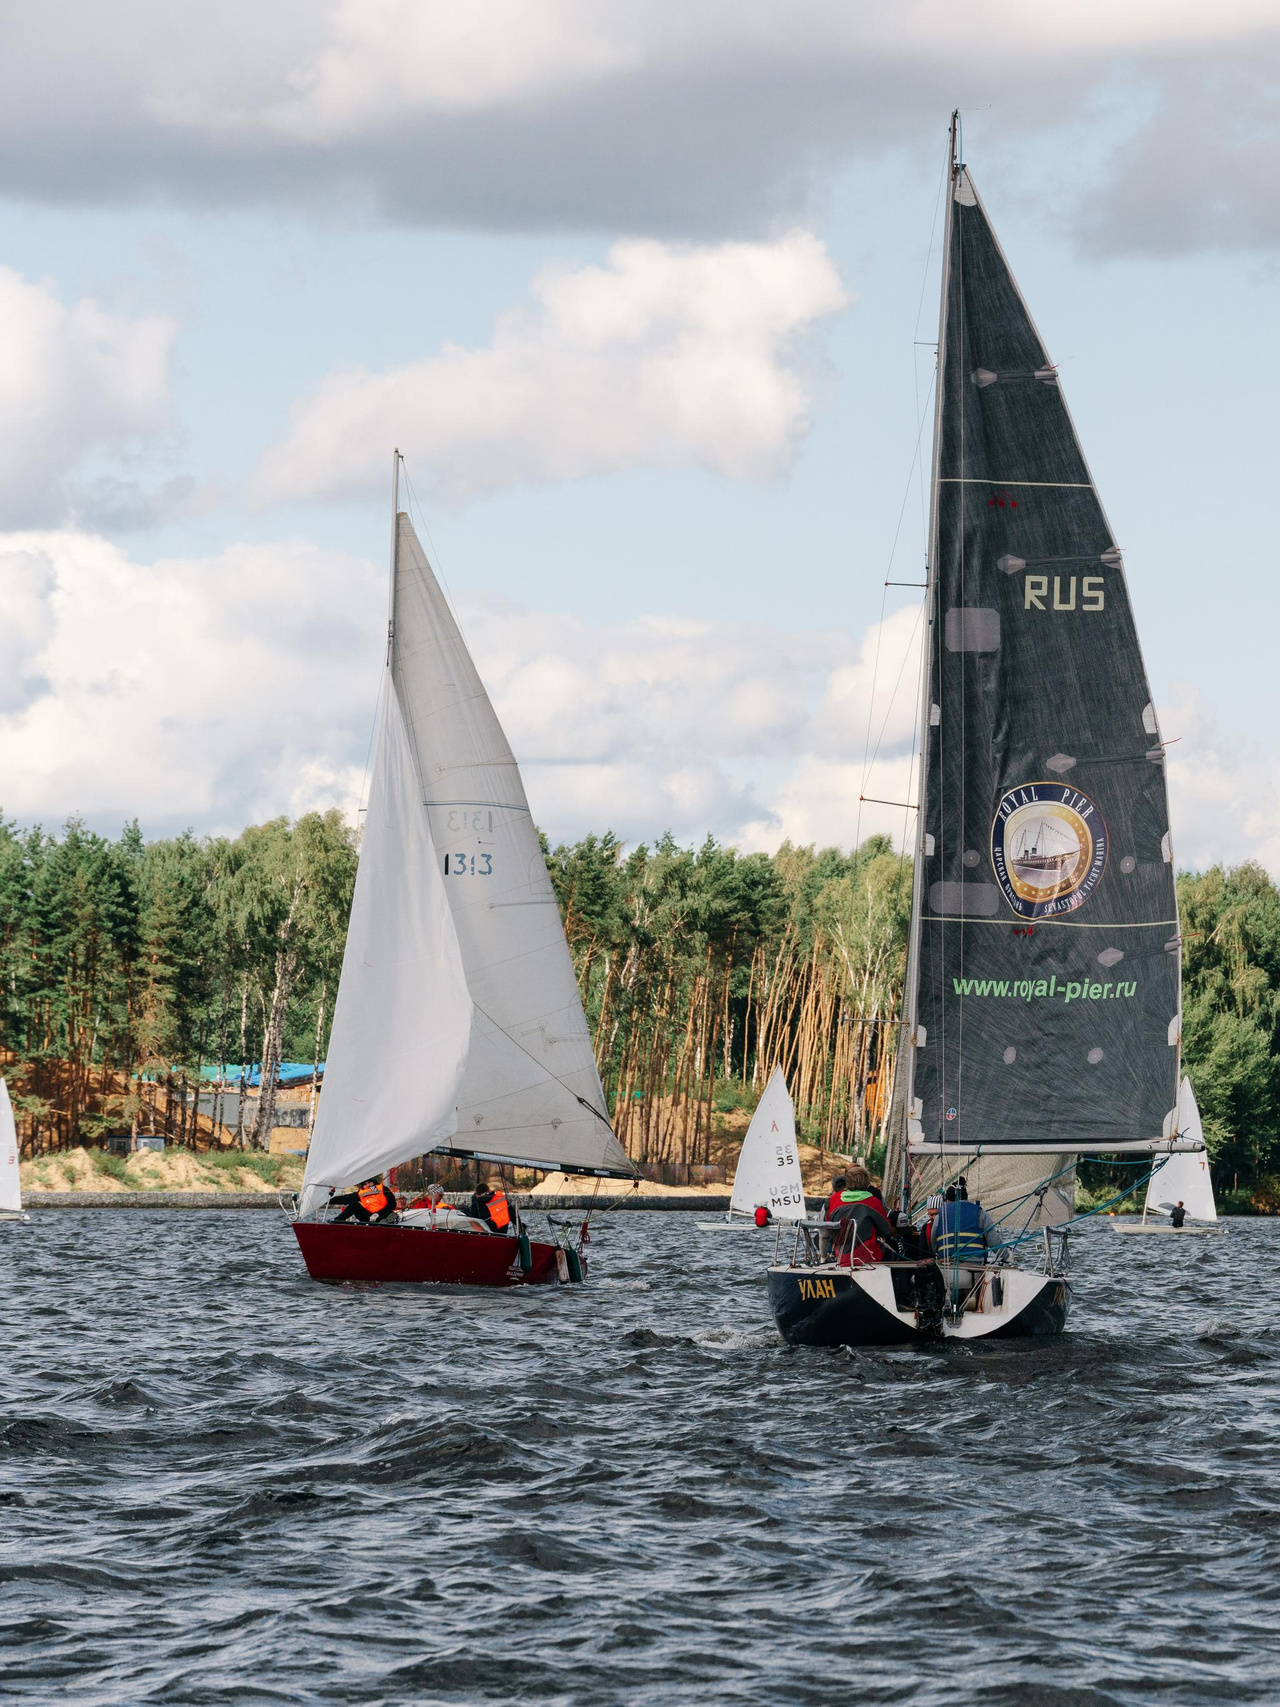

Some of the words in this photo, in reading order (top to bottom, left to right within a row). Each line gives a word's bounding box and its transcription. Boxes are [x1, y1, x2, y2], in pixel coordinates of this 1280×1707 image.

[1024, 575, 1105, 611] RUS
[998, 786, 1039, 822] ROYAL
[1060, 788, 1095, 819] PIER
[444, 853, 493, 876] 1313
[994, 847, 1007, 881] ЦАРСКАЯ
[1083, 867, 1101, 891] YACHT
[1094, 837, 1105, 866] MARINA
[952, 975, 1138, 1003] www.royal-pier.ru
[776, 1155, 794, 1167] 35
[771, 1194, 801, 1207] MSU
[797, 1279, 837, 1301] УЛАН
